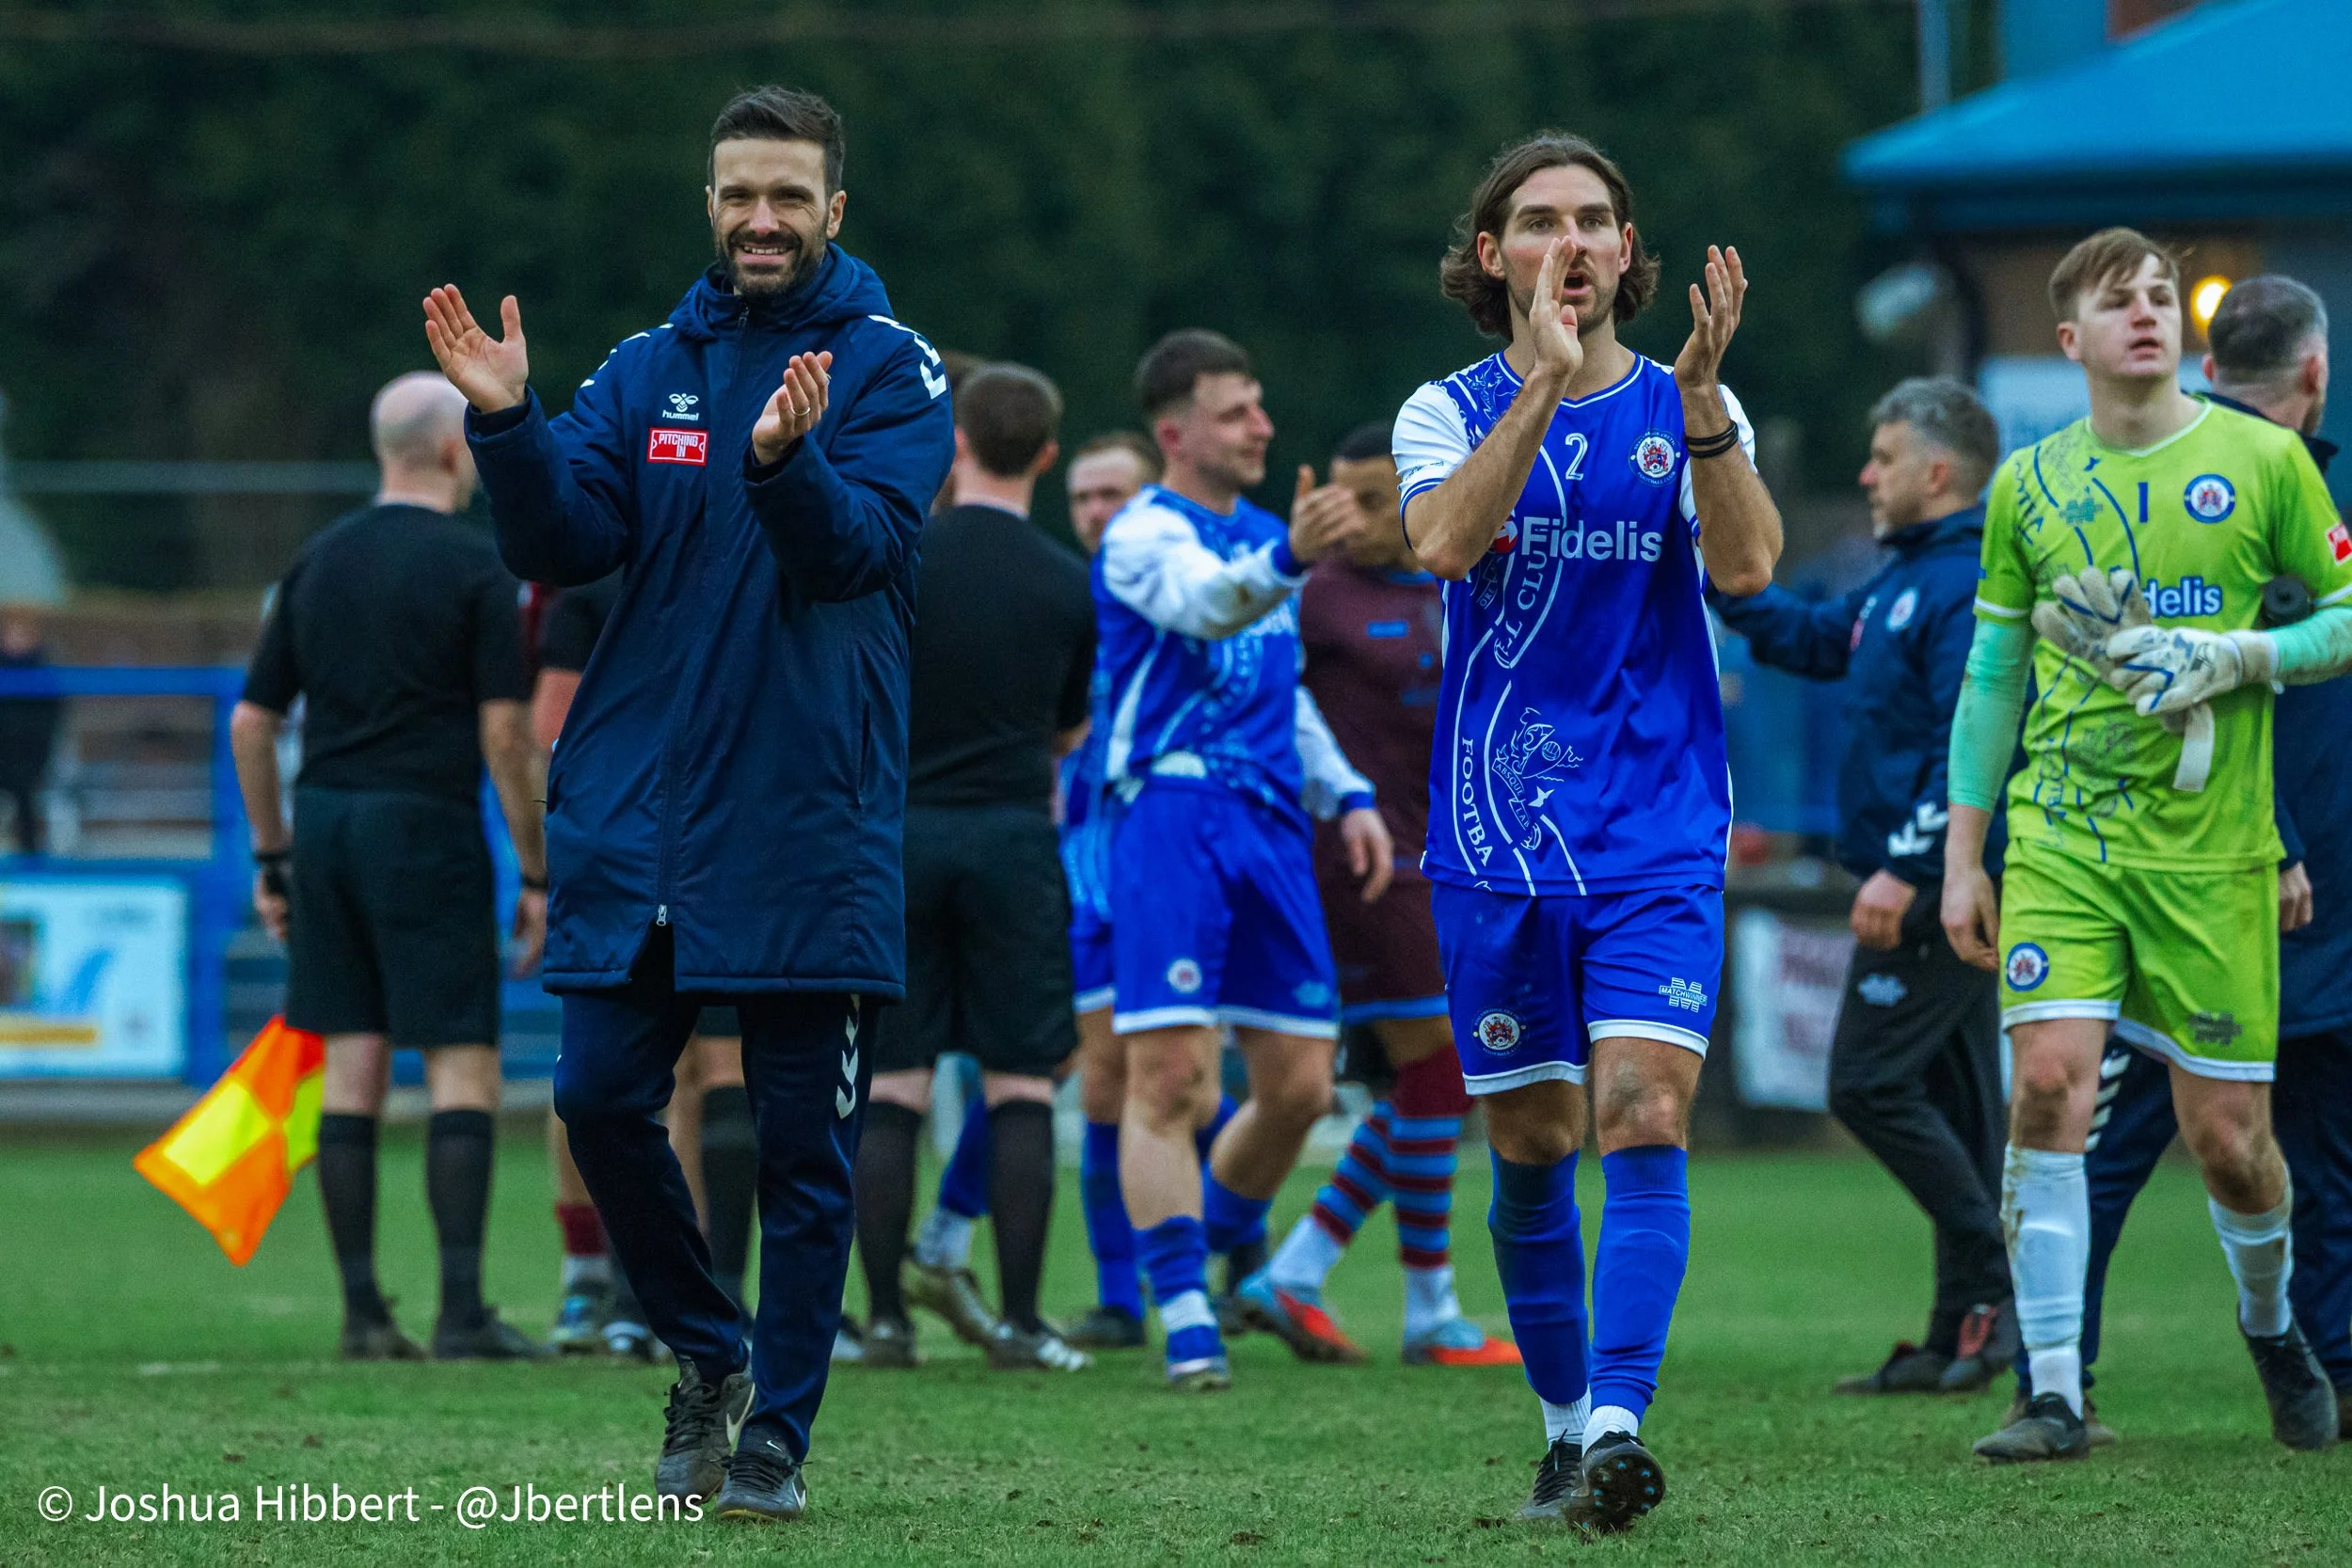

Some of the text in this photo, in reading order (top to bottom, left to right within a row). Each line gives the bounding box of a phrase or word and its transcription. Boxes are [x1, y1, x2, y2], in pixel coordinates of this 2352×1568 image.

[662, 410, 700, 420] hummel
[659, 433, 699, 447] PITCHING
[676, 445, 686, 457] IN
[1565, 433, 1588, 481] 2
[1521, 516, 1662, 562] Fidelis
[2144, 577, 2223, 617] delis
